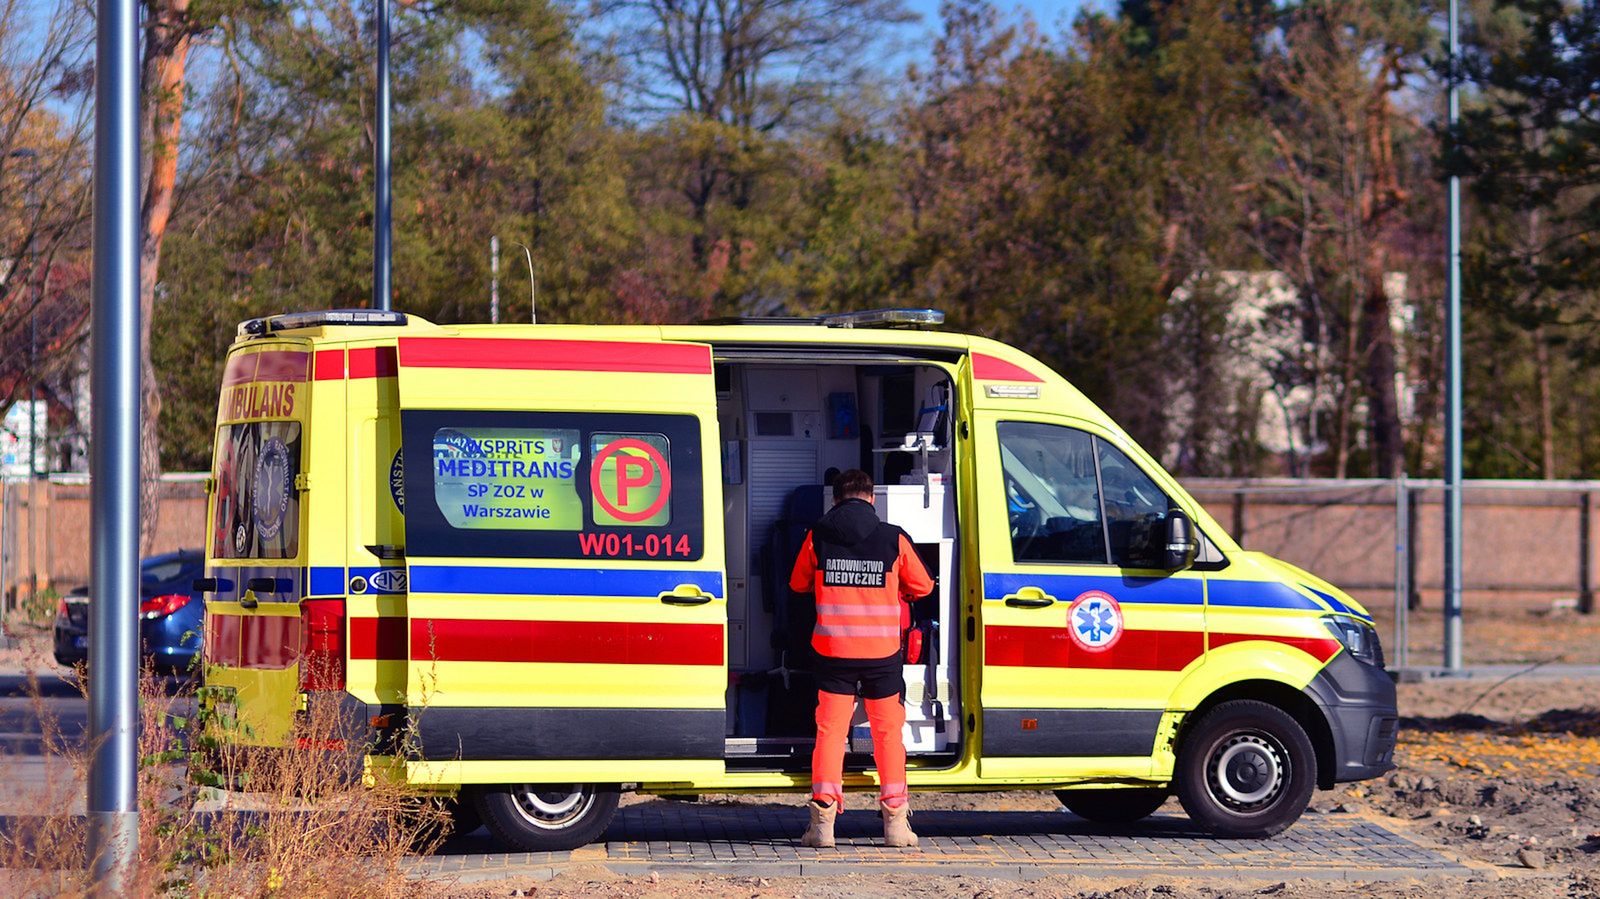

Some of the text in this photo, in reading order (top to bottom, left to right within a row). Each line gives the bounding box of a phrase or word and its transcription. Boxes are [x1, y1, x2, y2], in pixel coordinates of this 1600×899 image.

[438, 459, 573, 479] MEDITRANS
[616, 455, 654, 507] P
[467, 484, 544, 498] SP ZOZ w
[463, 504, 551, 519] Warszawie
[578, 533, 691, 557] W01-014
[826, 558, 884, 573] RATOWNICTWO
[825, 571, 883, 586] MEDYCZNE
